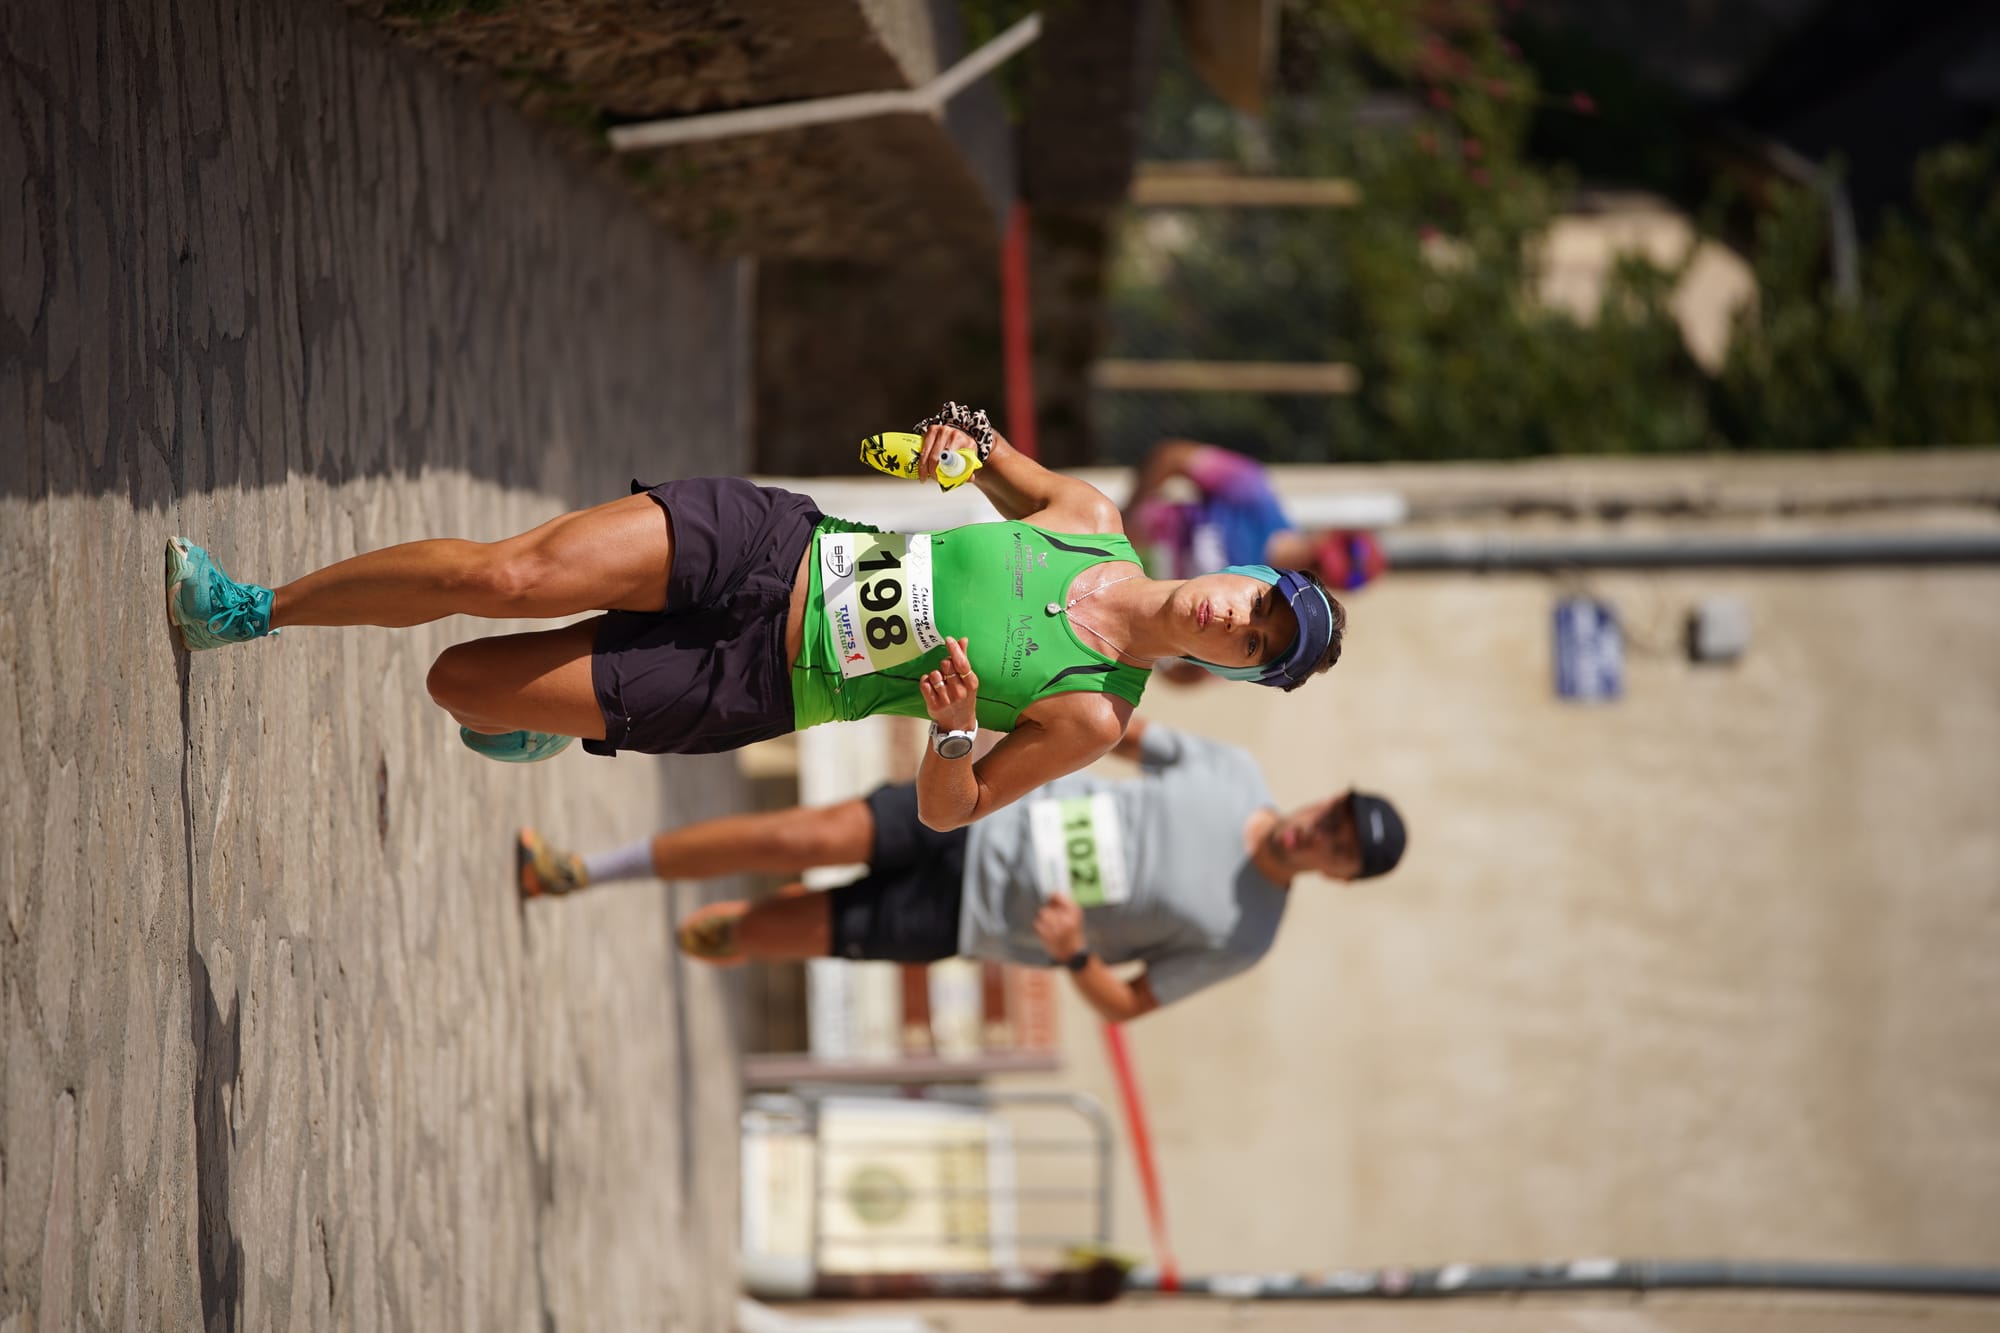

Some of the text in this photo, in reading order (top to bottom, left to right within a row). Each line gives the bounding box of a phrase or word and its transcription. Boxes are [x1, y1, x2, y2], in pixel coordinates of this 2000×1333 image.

[834, 545, 844, 573] BFP
[858, 550, 908, 650] 198
[912, 584, 921, 612] vallées
[921, 588, 930, 630] Challenge
[835, 611, 849, 655] Aventure
[840, 604, 856, 650] TUFF'S
[1011, 614, 1033, 678] Marvejols
[1063, 817, 1100, 887] 102
